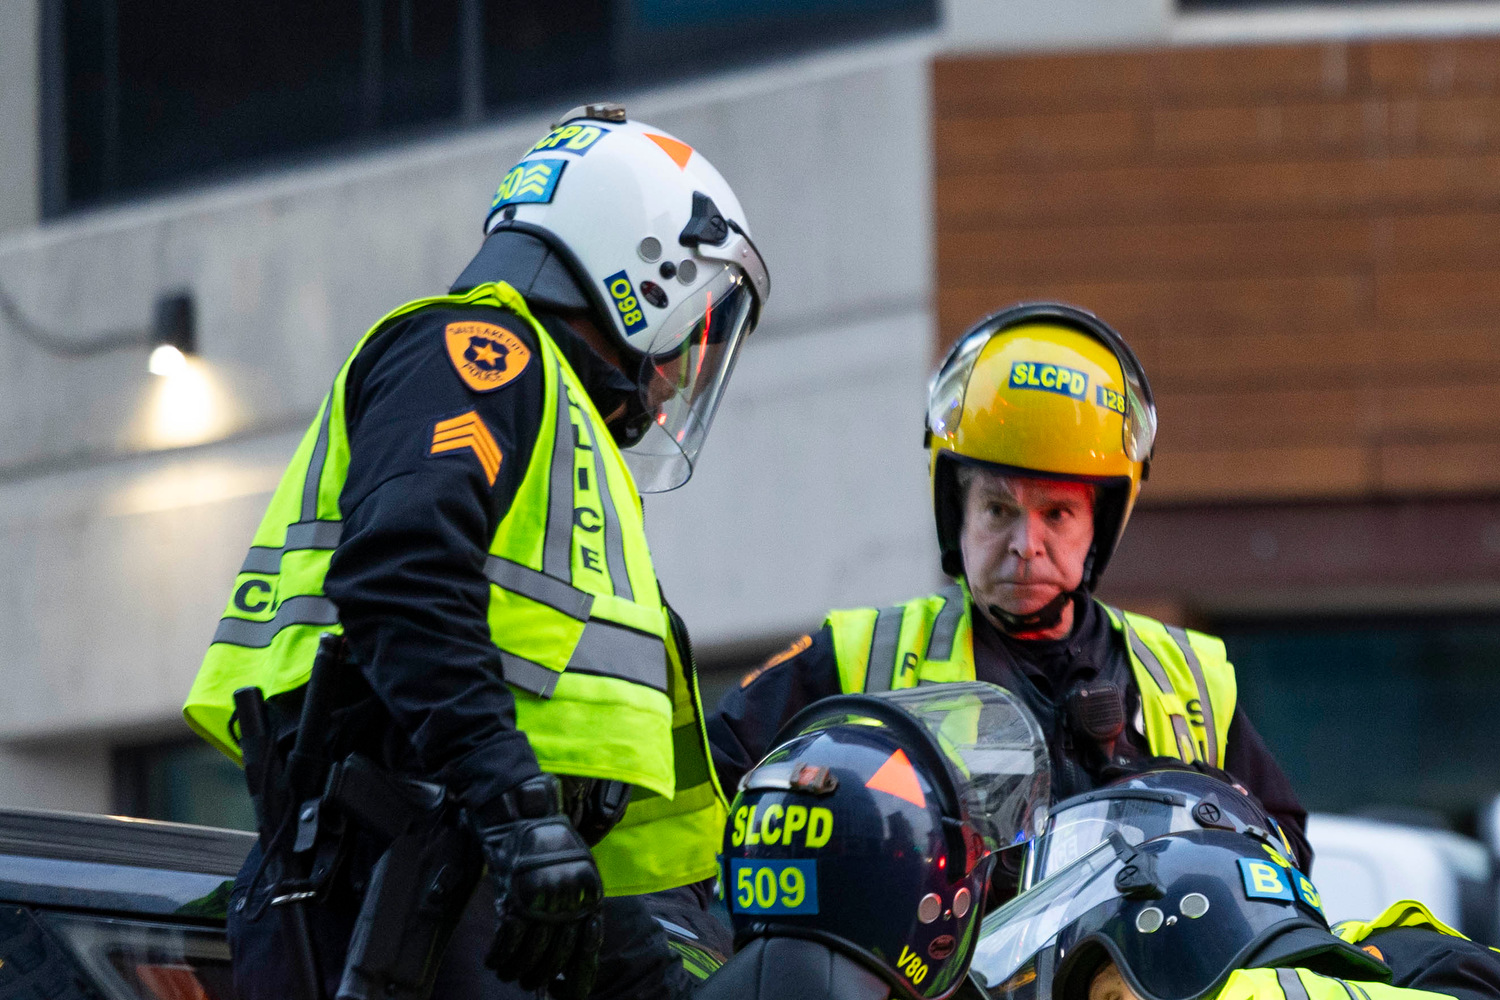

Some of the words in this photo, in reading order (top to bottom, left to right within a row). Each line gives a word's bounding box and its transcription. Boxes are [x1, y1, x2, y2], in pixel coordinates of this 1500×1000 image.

[1013, 363, 1085, 395] SLCPD
[1103, 388, 1125, 413] 128
[732, 804, 834, 848] SLCPD
[737, 867, 805, 908] 509
[1249, 863, 1283, 893] B
[896, 944, 929, 985] V80
